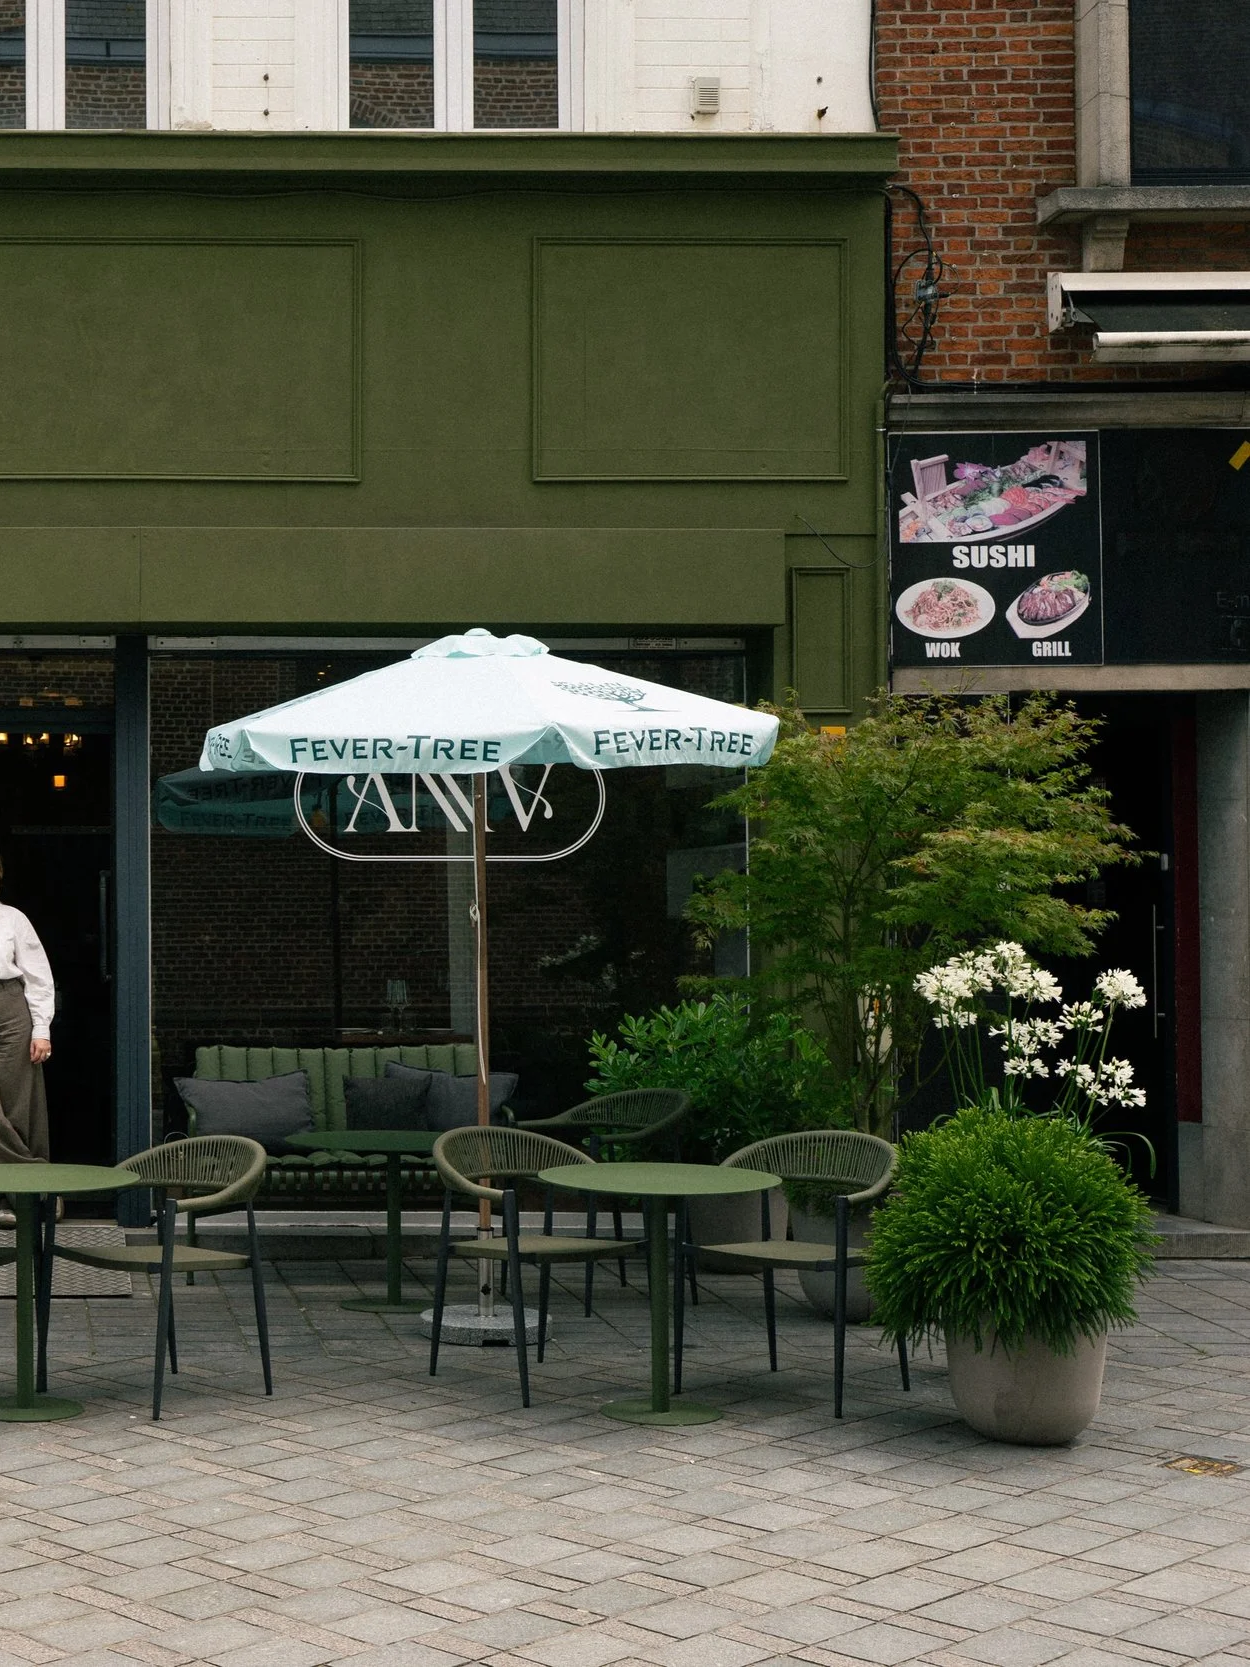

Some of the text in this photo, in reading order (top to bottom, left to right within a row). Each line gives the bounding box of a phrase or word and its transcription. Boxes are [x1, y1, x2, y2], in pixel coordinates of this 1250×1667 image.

[952, 545, 1036, 569] SUSHI
[925, 642, 961, 658] WOK
[1032, 641, 1072, 657] GRILL
[289, 735, 501, 763] FEVER-TREE
[594, 727, 754, 756] FEVER-TREE
